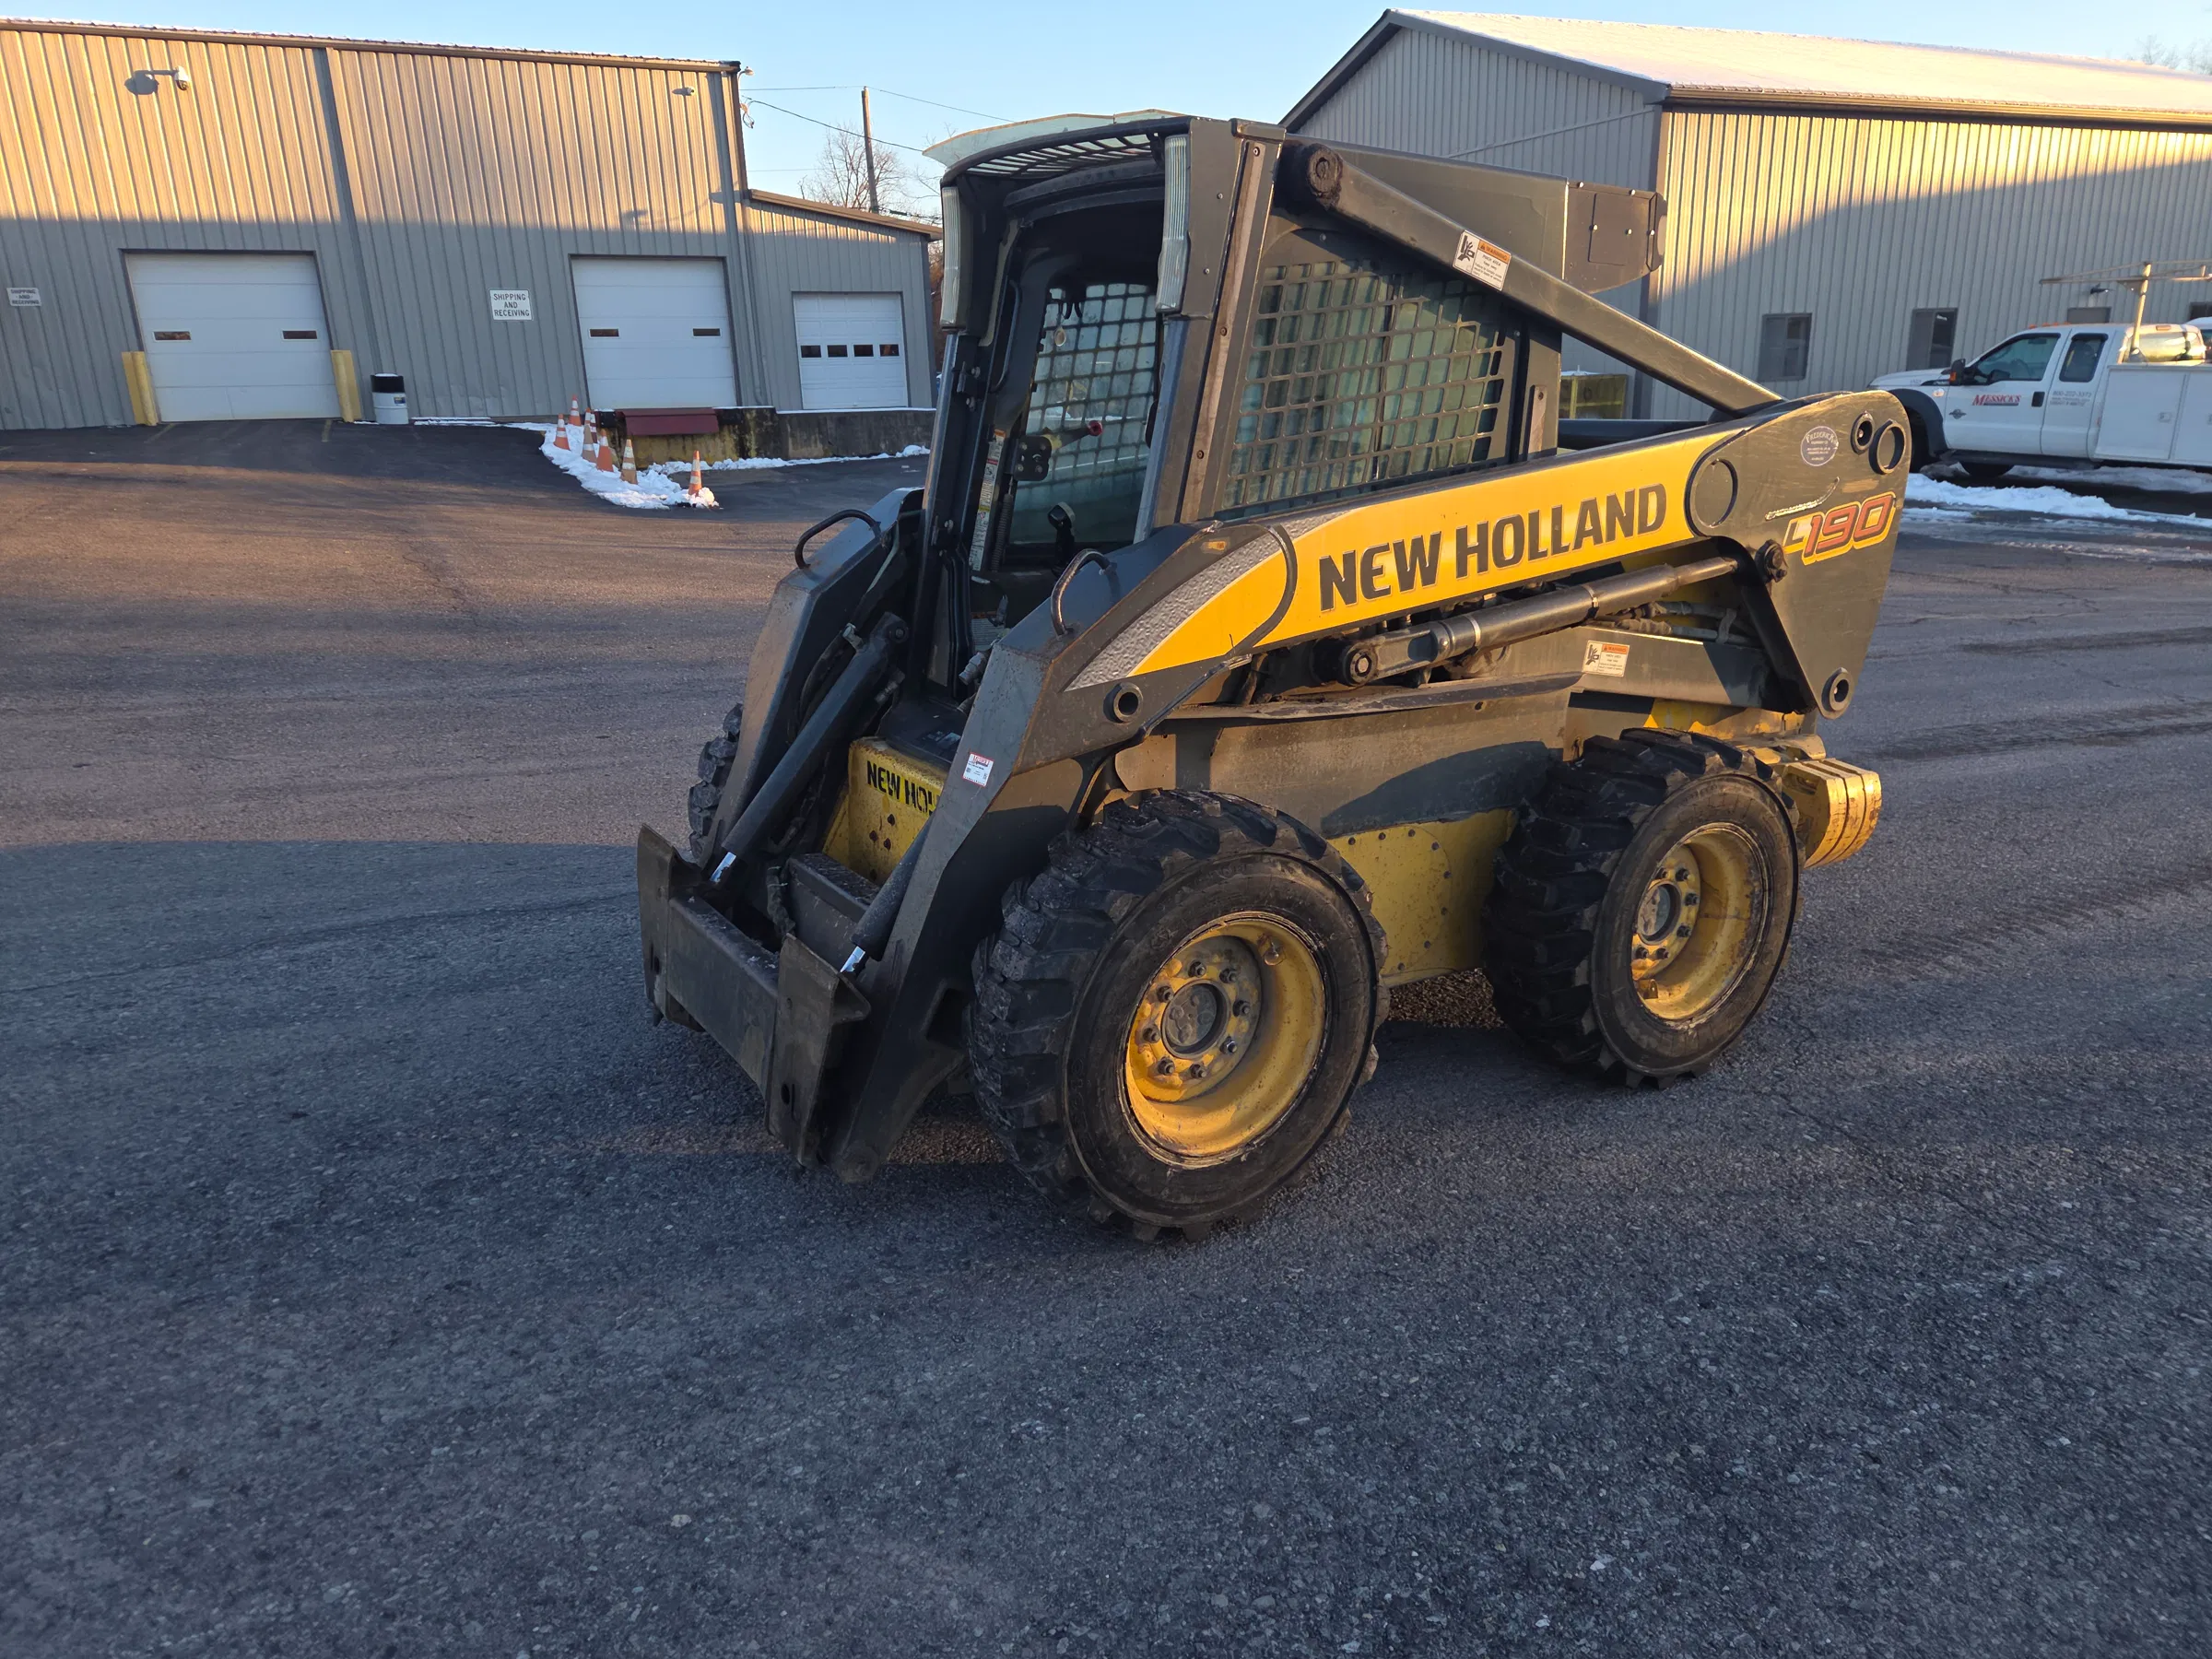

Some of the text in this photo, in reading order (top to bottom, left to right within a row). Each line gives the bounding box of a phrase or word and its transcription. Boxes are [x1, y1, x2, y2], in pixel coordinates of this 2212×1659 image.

[1319, 482, 1667, 612] NEW HOLLAND
[1783, 492, 1896, 563] L190
[866, 760, 901, 800] NEW
